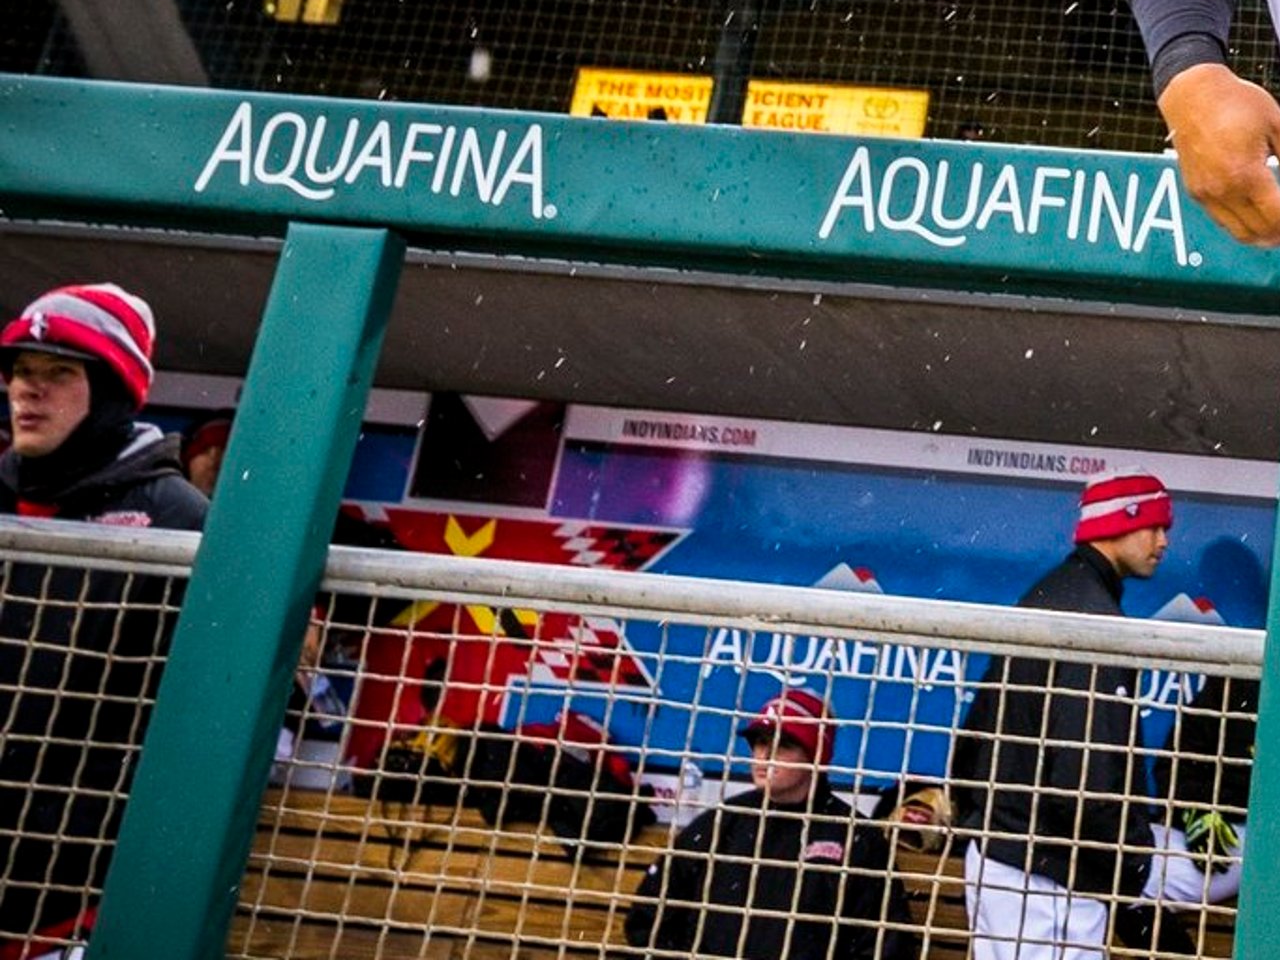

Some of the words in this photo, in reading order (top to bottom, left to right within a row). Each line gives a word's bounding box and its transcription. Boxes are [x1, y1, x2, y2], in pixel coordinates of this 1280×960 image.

[752, 89, 829, 109] ICIENT
[195, 101, 545, 218] AQUAFINA
[819, 146, 1190, 266] AQUAFINA
